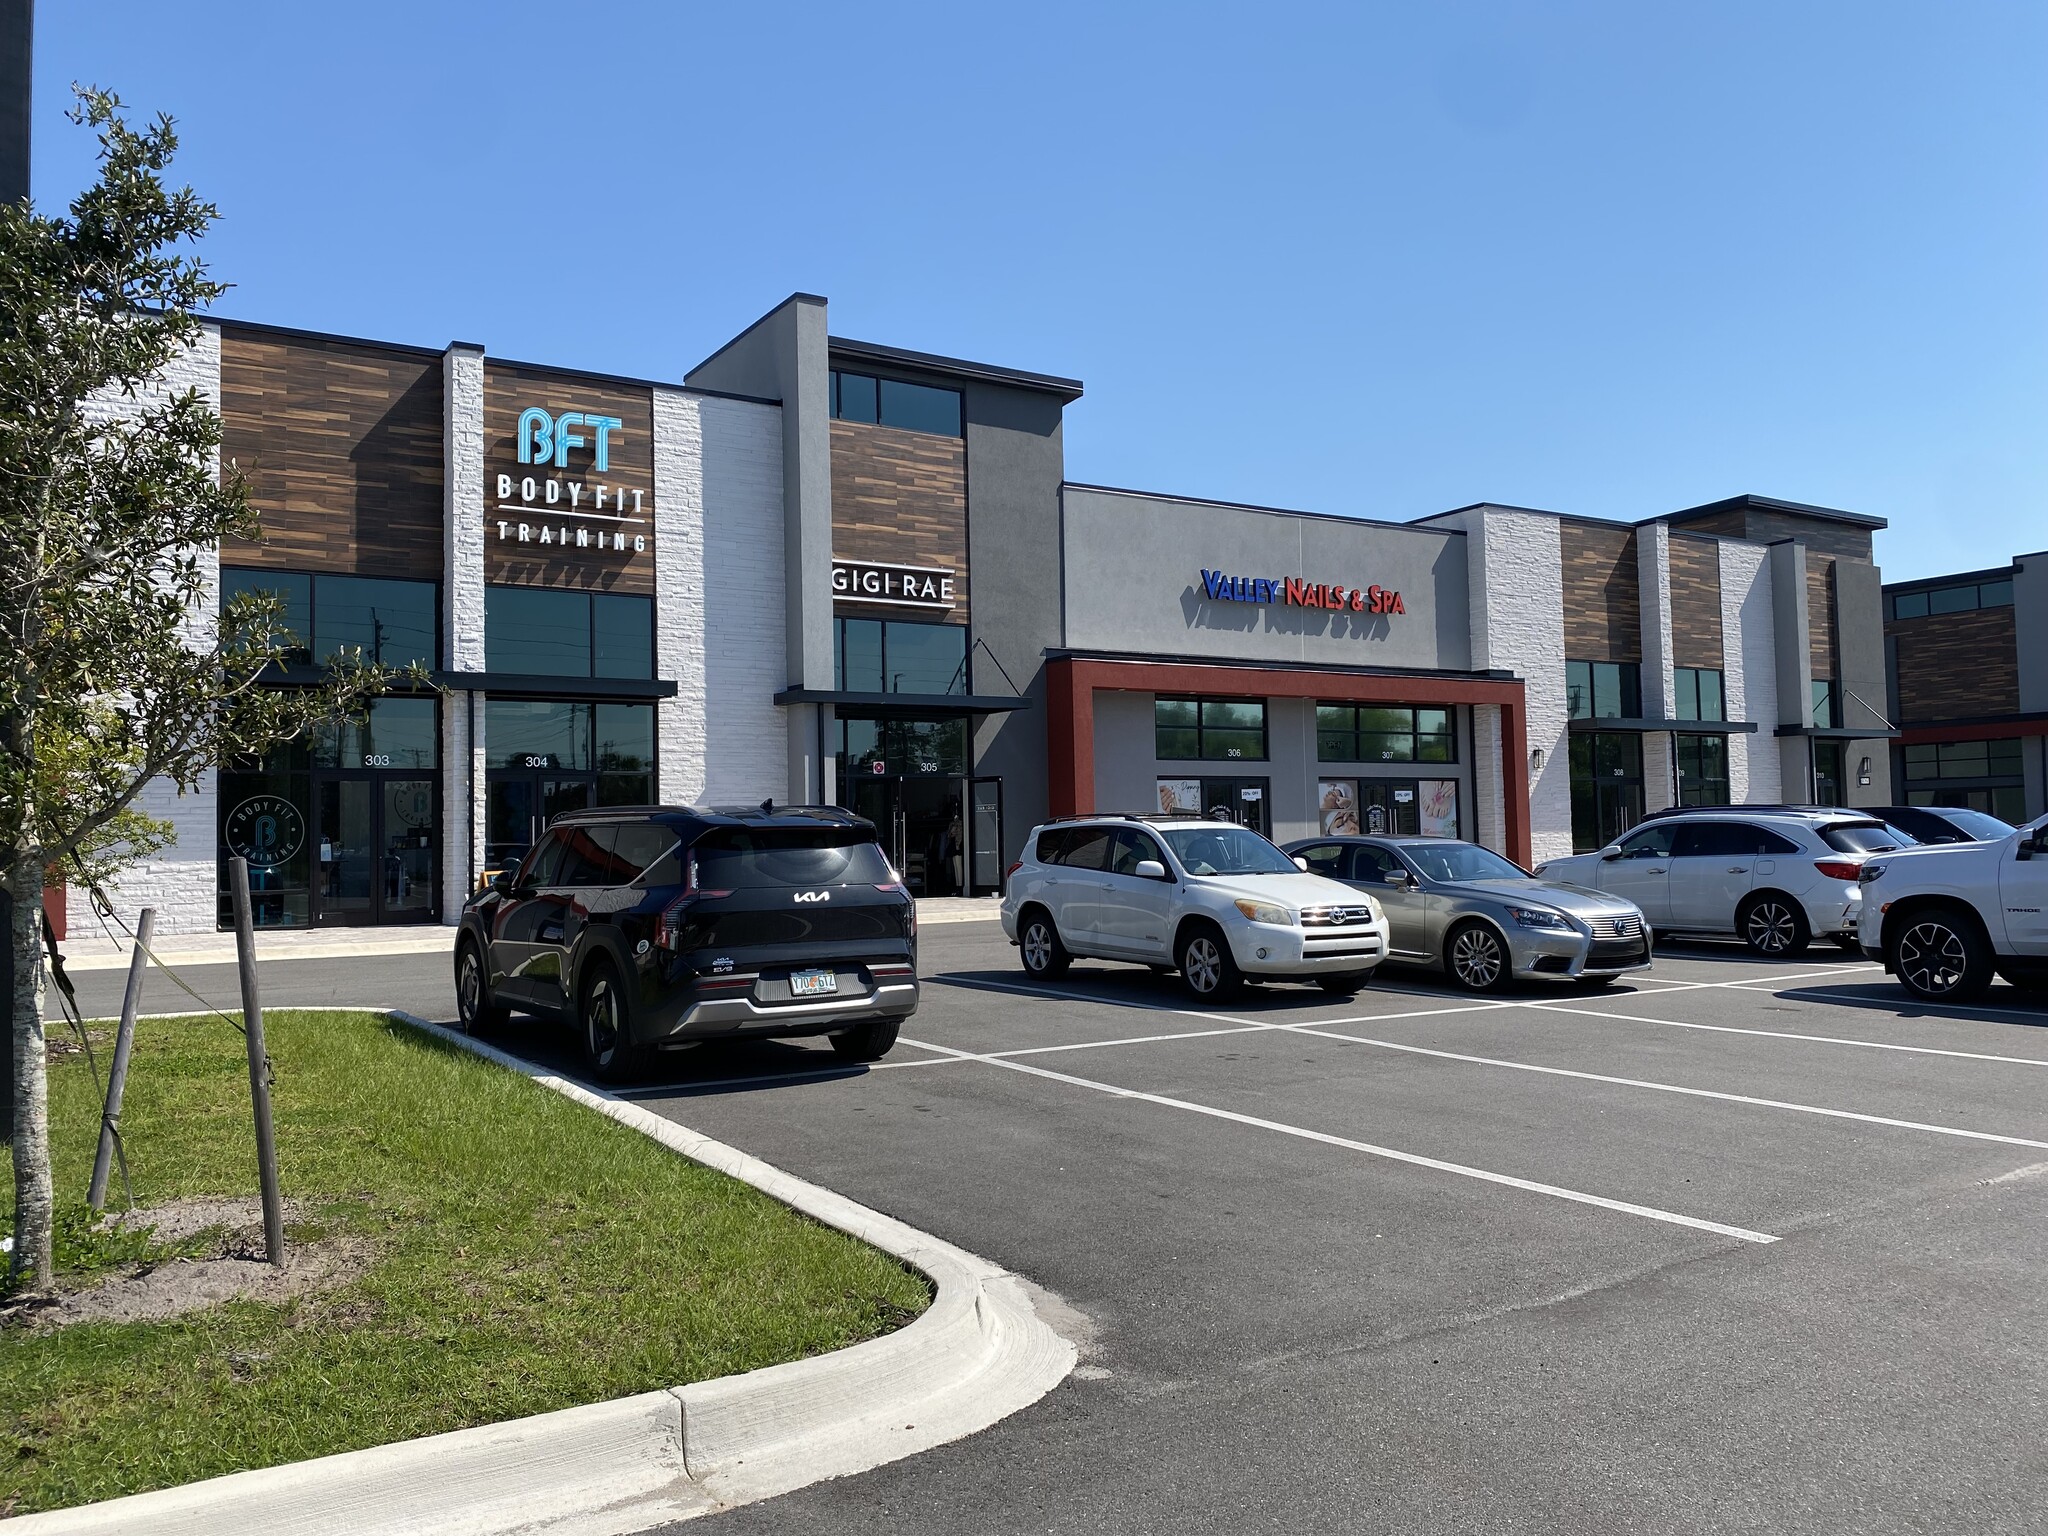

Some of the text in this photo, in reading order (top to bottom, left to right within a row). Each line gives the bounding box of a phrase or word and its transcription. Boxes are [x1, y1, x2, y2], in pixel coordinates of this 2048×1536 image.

[518, 407, 622, 472] BFT
[497, 474, 645, 512] BODY FIT
[497, 521, 645, 552] TRAINING
[832, 568, 954, 599] GIGI RAE
[1350, 589, 1363, 611] &
[365, 754, 390, 766] 303
[525, 757, 548, 767] 304
[1228, 748, 1241, 757] 306
[1381, 751, 1394, 759] 307
[921, 763, 937, 771] 305
[237, 801, 294, 821] BODY FIT
[237, 841, 294, 861] TRAINING
